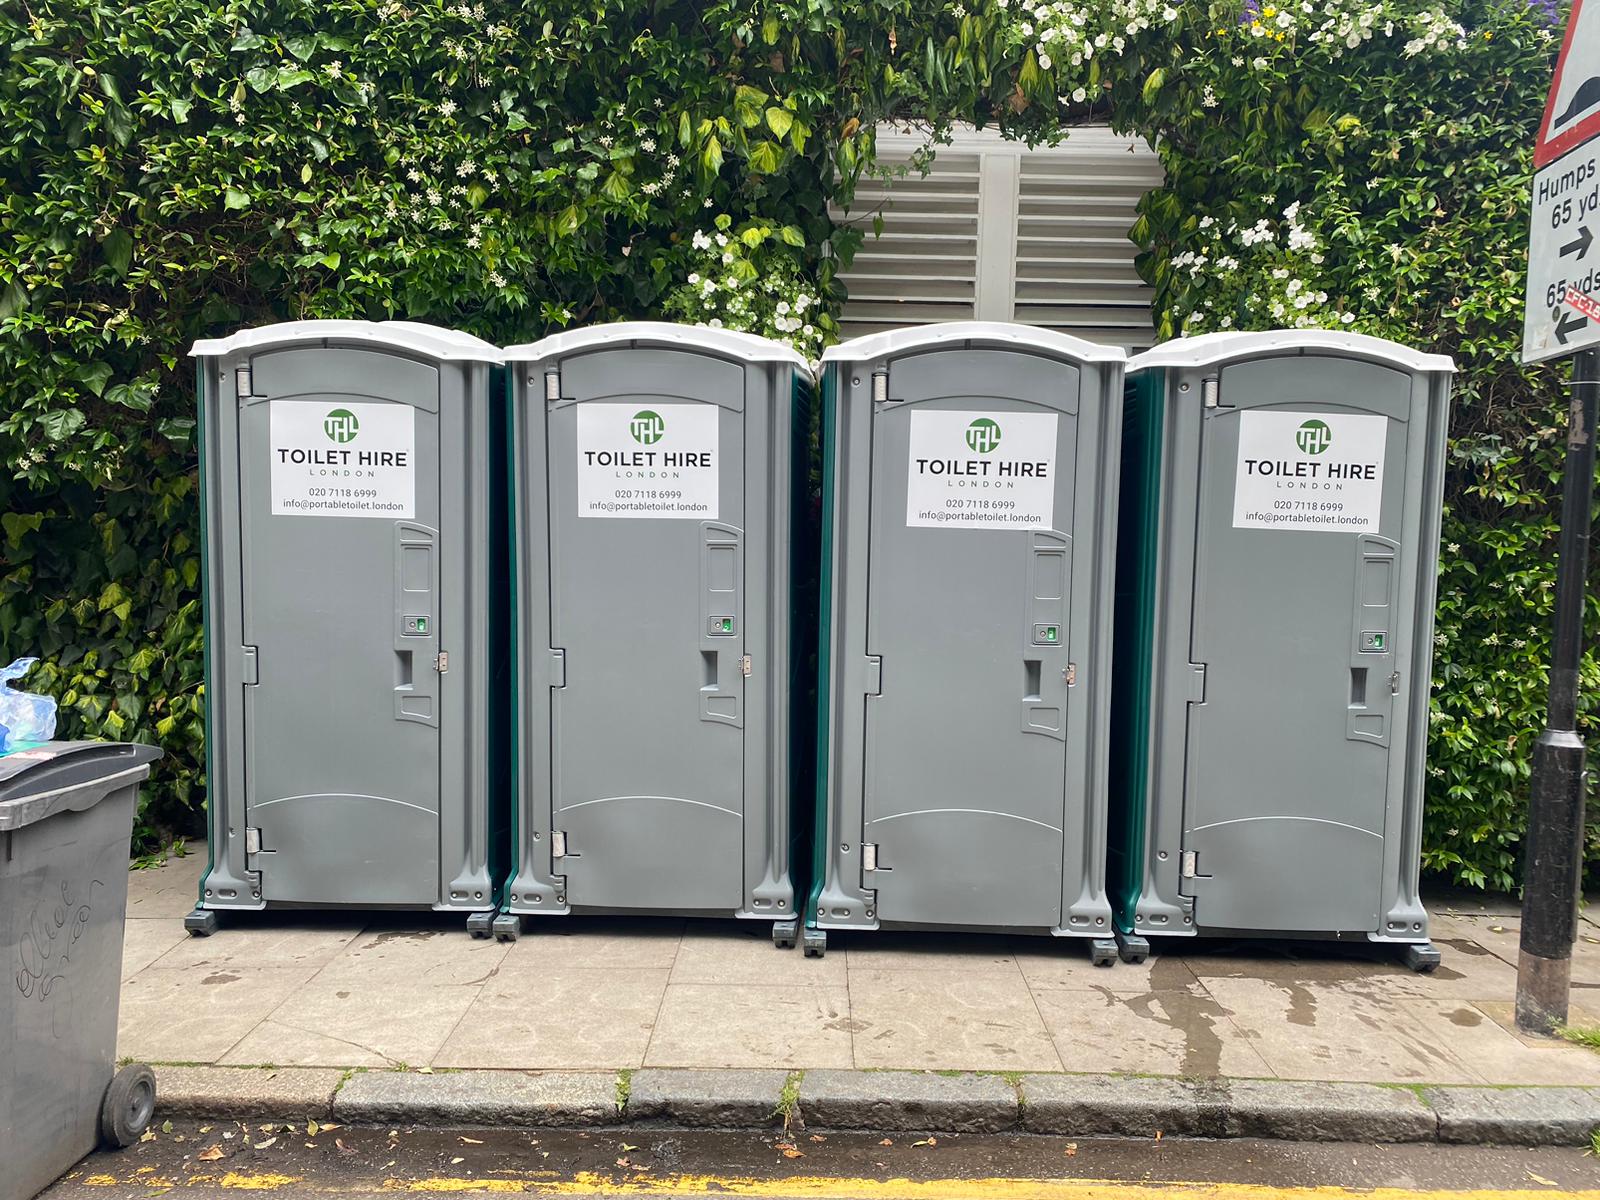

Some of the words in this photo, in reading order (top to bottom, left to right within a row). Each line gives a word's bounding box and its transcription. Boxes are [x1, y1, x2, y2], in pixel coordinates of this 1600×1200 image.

[1538, 158, 1596, 205] Humps
[1552, 198, 1572, 229] 65
[1578, 184, 1600, 222] yd
[1546, 279, 1566, 308] 65
[325, 414, 360, 443] THL
[630, 416, 664, 444] THL
[966, 424, 1001, 453] THL
[1296, 426, 1332, 454] THL
[278, 449, 351, 464] TOILET
[359, 451, 407, 466] HIRE
[584, 451, 656, 466] TOILET
[664, 452, 711, 467] HIRE
[310, 469, 374, 477] LONDON
[916, 459, 991, 476] TOILET
[999, 462, 1047, 478] HIRE
[1245, 460, 1321, 478] TOILET
[1328, 464, 1376, 480] HIRE
[948, 480, 1014, 489] LONDON
[1277, 481, 1343, 490] LONDON
[308, 488, 326, 496] 020
[328, 488, 352, 497] 7118
[354, 489, 377, 498] 6999
[615, 490, 632, 498] 020
[634, 490, 656, 498] 7118
[659, 490, 682, 499] 6999
[283, 499, 404, 510] info@portabletoilet.london
[590, 502, 708, 512] info@portabletoilet.london
[946, 499, 963, 508] 020
[966, 500, 989, 509] 7118
[992, 500, 1015, 509] 6999
[1274, 500, 1292, 509] 020
[1295, 501, 1318, 510] 7118
[1320, 502, 1343, 511] 6999
[919, 511, 1041, 522] info@portabletoilet.london
[1246, 512, 1368, 525] info@portabletoilet.london
